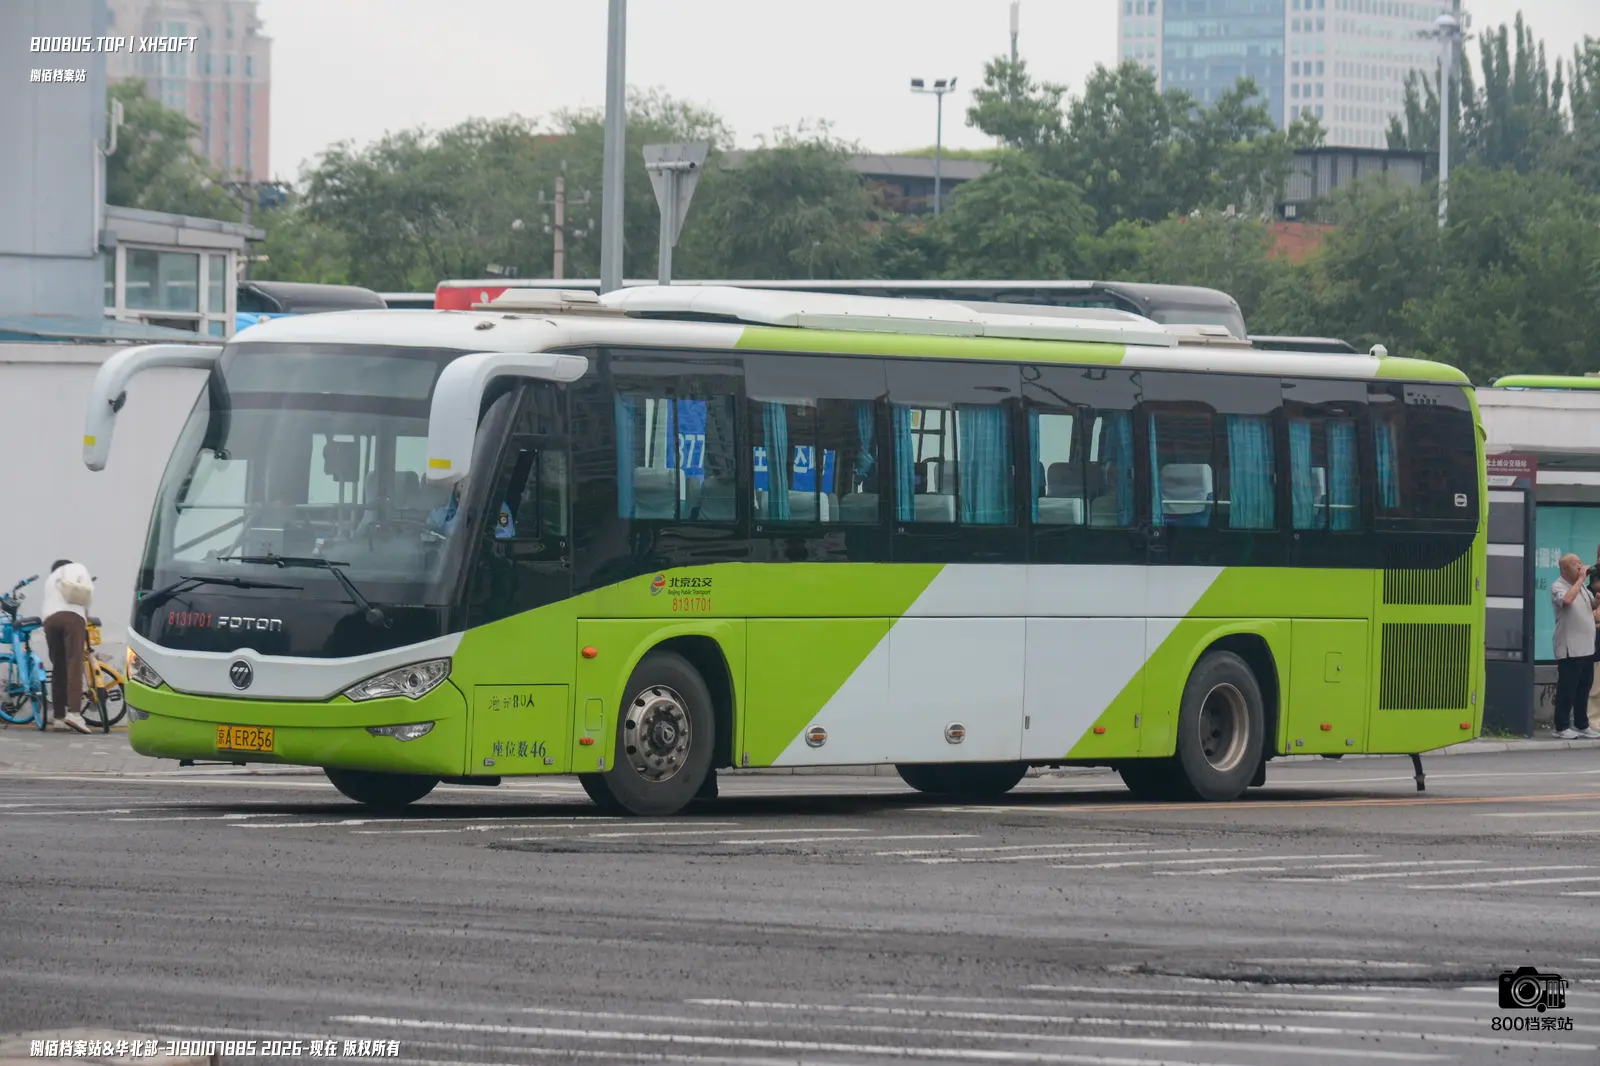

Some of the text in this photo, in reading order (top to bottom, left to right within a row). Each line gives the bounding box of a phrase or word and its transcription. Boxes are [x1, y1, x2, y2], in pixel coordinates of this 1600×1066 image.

[668, 577, 712, 588] 北京公交
[672, 597, 711, 612] 8131701
[168, 611, 212, 627] 8131701
[217, 616, 282, 632] FOTON
[492, 741, 547, 758] 座位数46
